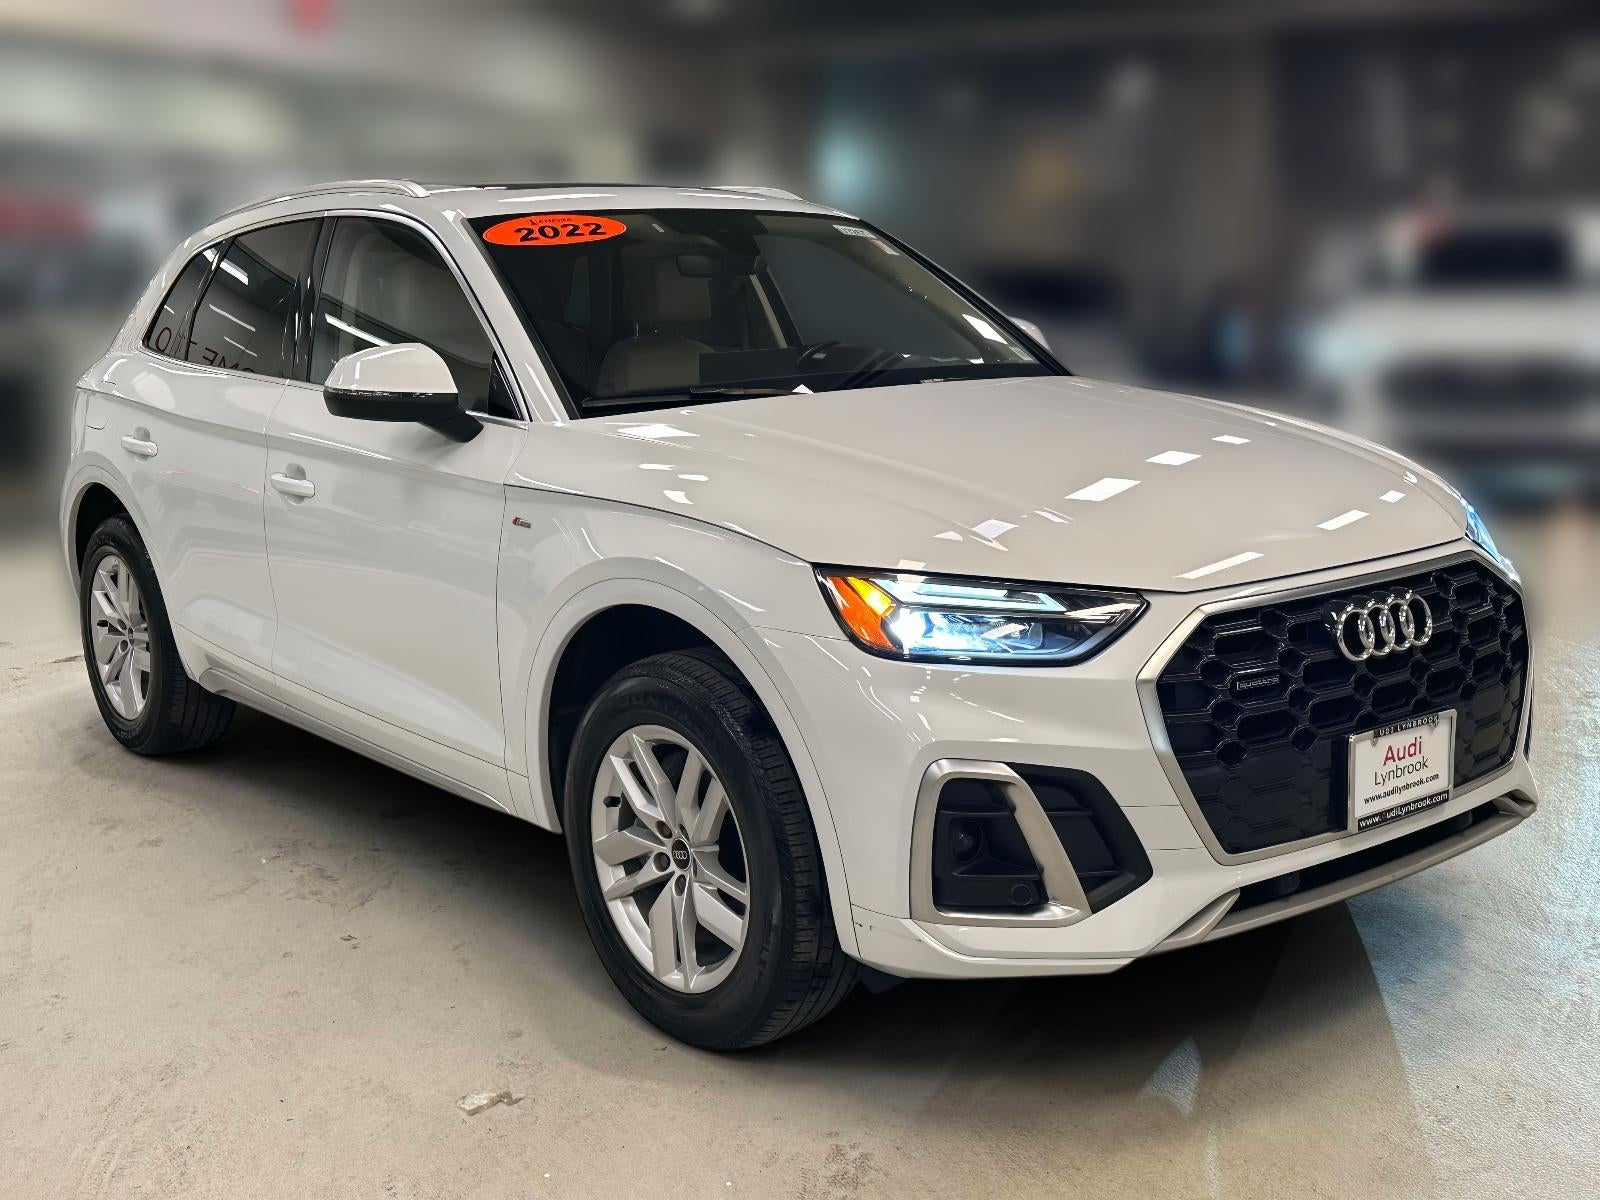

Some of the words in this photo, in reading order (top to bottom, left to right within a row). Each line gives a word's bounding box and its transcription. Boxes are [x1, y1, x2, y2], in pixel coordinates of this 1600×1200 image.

[514, 222, 607, 242] 2022
[1397, 715, 1439, 731] LYNBROOK
[1383, 736, 1422, 766] Audi
[1374, 756, 1429, 786] Lynbrook
[1363, 773, 1440, 804] www.audilynbrook.com
[1359, 792, 1448, 827] www.AudiLynbrook.com
